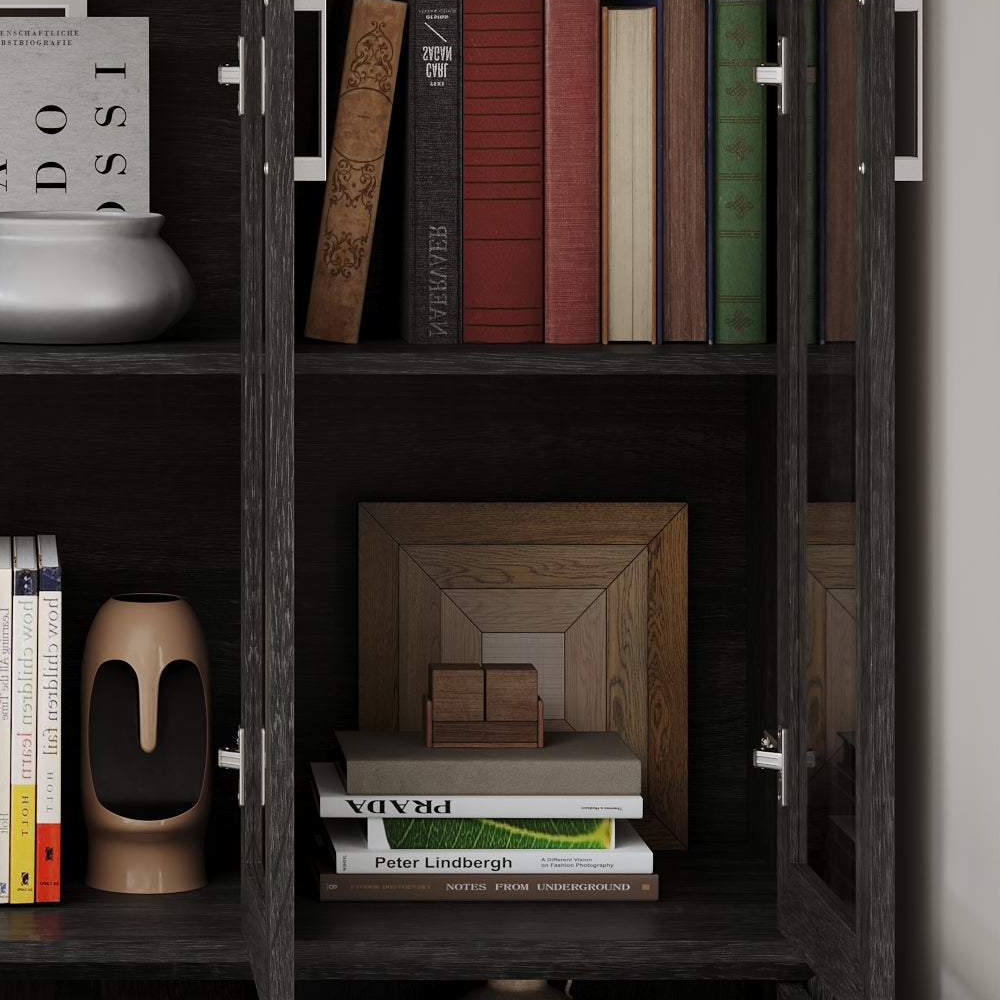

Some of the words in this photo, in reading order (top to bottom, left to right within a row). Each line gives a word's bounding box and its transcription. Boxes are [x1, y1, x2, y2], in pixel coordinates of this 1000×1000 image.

[35, 104, 68, 194] DO
[344, 799, 452, 814] PRADA
[374, 856, 420, 870] Peter
[425, 856, 513, 872] Lindbergh
[446, 882, 487, 892] NOTES
[495, 882, 530, 892] FROM
[536, 882, 631, 892] UNDERGROUND
